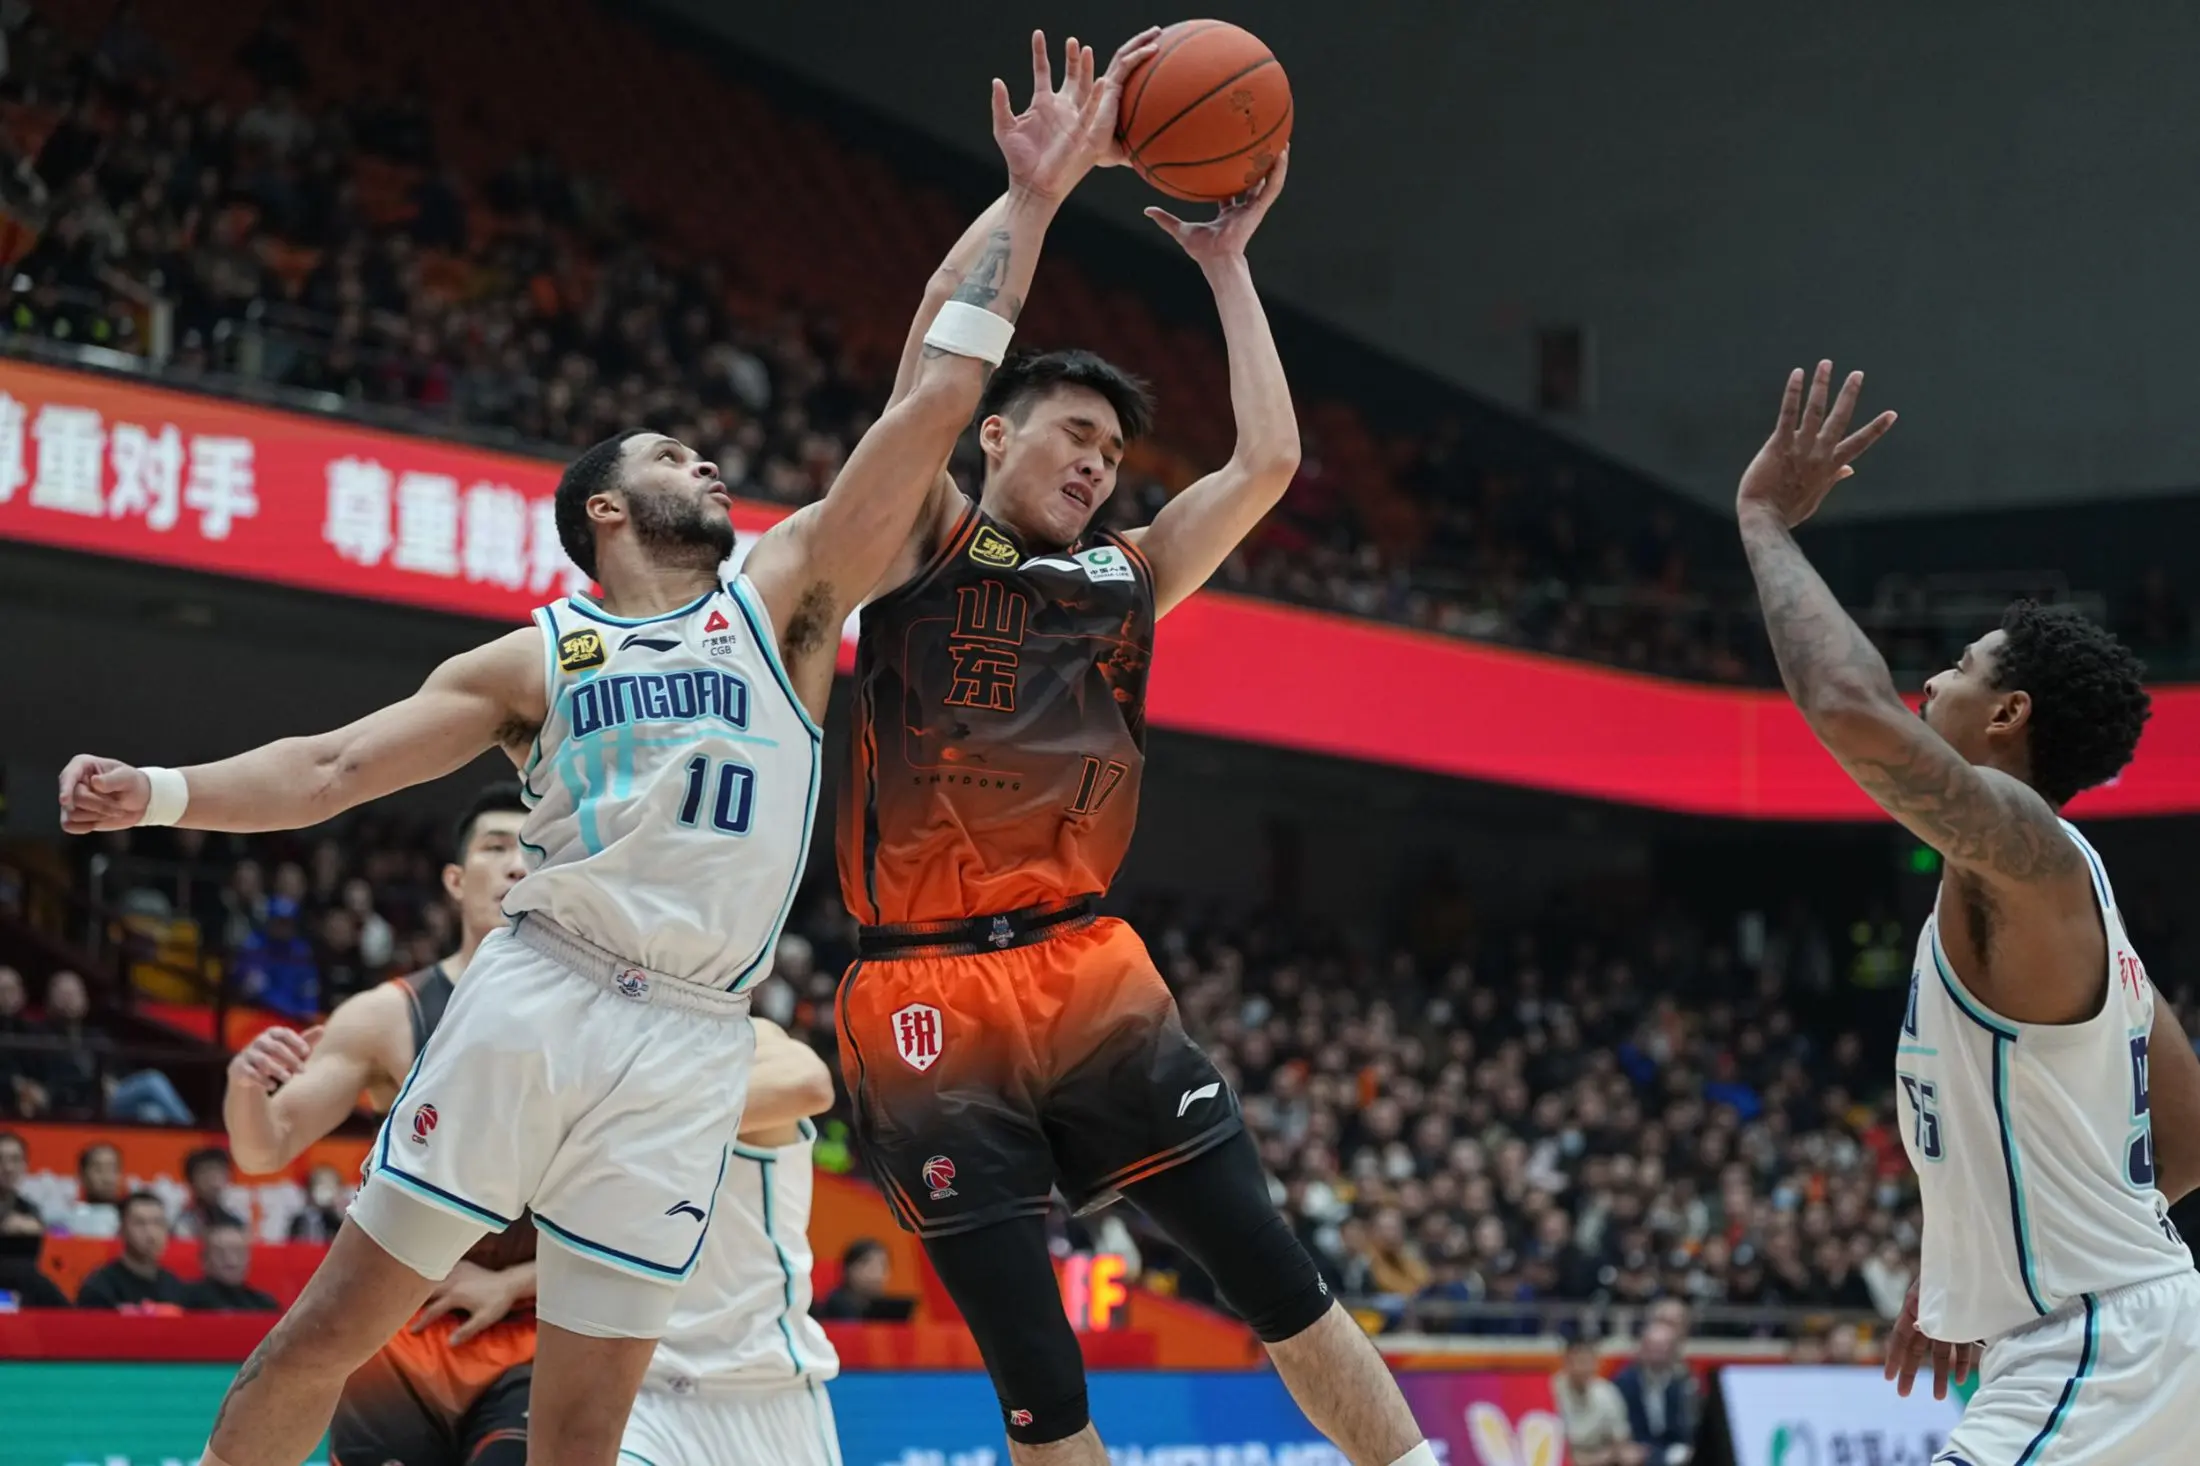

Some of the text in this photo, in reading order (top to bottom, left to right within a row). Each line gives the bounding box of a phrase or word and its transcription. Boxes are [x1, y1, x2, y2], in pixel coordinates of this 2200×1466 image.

[710, 645, 732, 656] CGB
[944, 579, 1027, 712] 山东
[571, 669, 751, 741] QINGDAO
[678, 753, 757, 837] 10
[1066, 755, 1128, 815] 17
